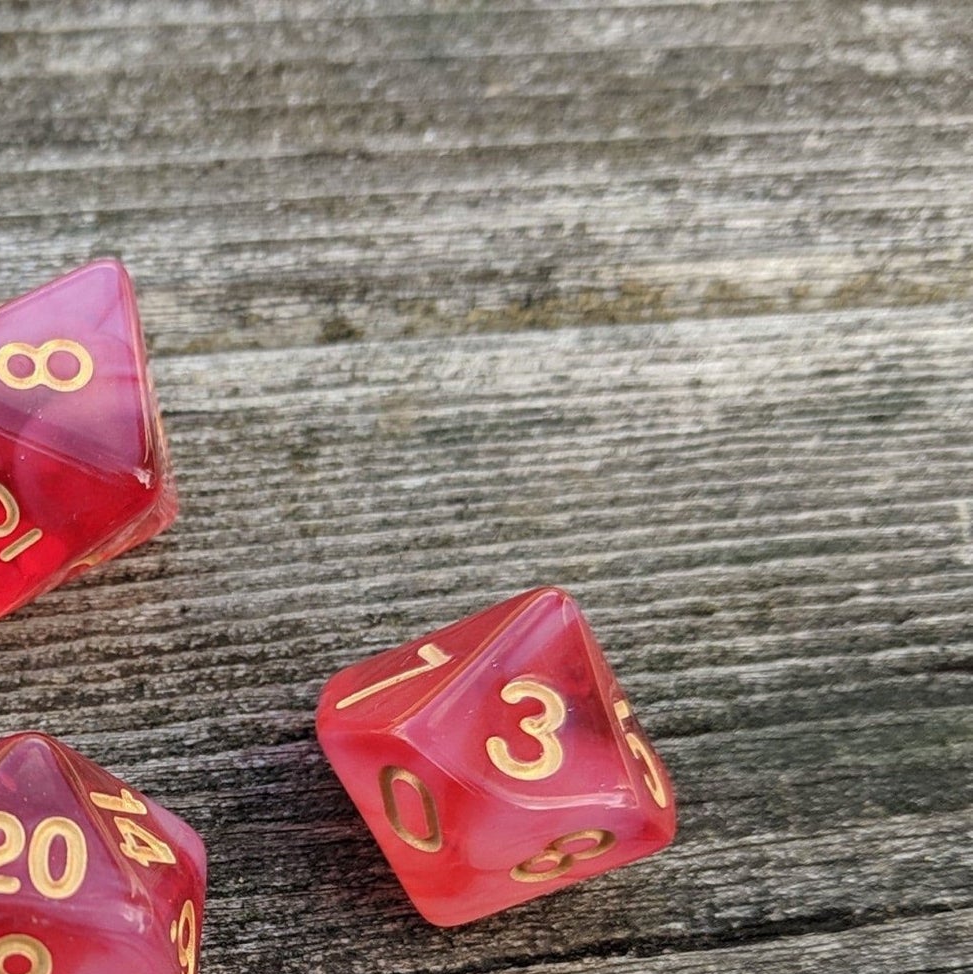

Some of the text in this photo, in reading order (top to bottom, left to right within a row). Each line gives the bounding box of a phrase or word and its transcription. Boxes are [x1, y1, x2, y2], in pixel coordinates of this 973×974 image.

[335, 644, 454, 709] 1
[486, 680, 565, 780] 3
[90, 789, 177, 866] 14
[378, 765, 442, 853] 0
[510, 829, 615, 882] 8
